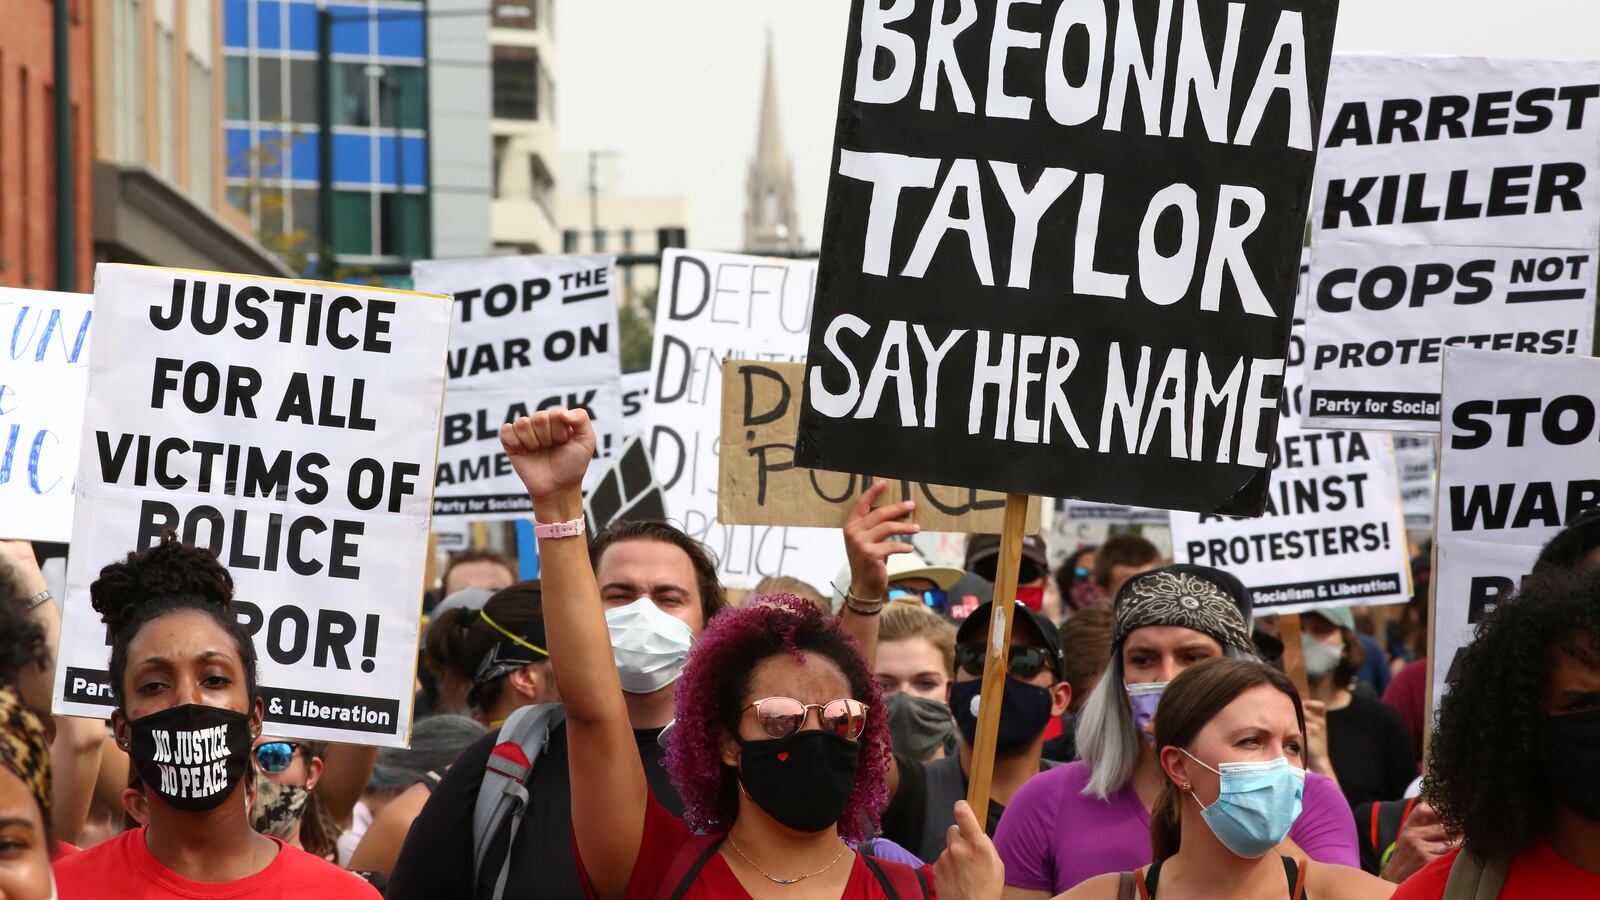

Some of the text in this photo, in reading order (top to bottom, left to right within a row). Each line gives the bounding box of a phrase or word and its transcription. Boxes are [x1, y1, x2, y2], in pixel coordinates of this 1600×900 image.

[853, 0, 1313, 151] BREONNA
[1324, 84, 1600, 149] ARREST
[1321, 161, 1586, 230] KILLER
[838, 148, 1278, 318] TAYLOR
[448, 267, 608, 323] TOP THE
[1316, 260, 1496, 313] COPS
[1509, 255, 1589, 284] NOT
[149, 279, 396, 354] JUSTICE
[543, 323, 608, 363] ON
[150, 357, 376, 431] FOR ALL
[809, 313, 969, 429] SAY
[967, 329, 1089, 449] HER
[1098, 341, 1284, 467] NAME
[1316, 397, 1361, 415] Party
[1365, 398, 1388, 413] for
[1392, 399, 1440, 415] Social
[1452, 394, 1600, 449] STO
[96, 430, 420, 512] VICTIMS OF
[434, 500, 466, 513] Party
[468, 499, 486, 511] for
[136, 500, 365, 580] POLICE
[1187, 521, 1390, 567] PROTESTERS!
[1252, 579, 1396, 604] Socialism & Liberation
[268, 697, 284, 716] &
[290, 699, 390, 726] Liberation
[151, 723, 231, 765] NO JUSTICE
[157, 759, 228, 798] NO PEACE
